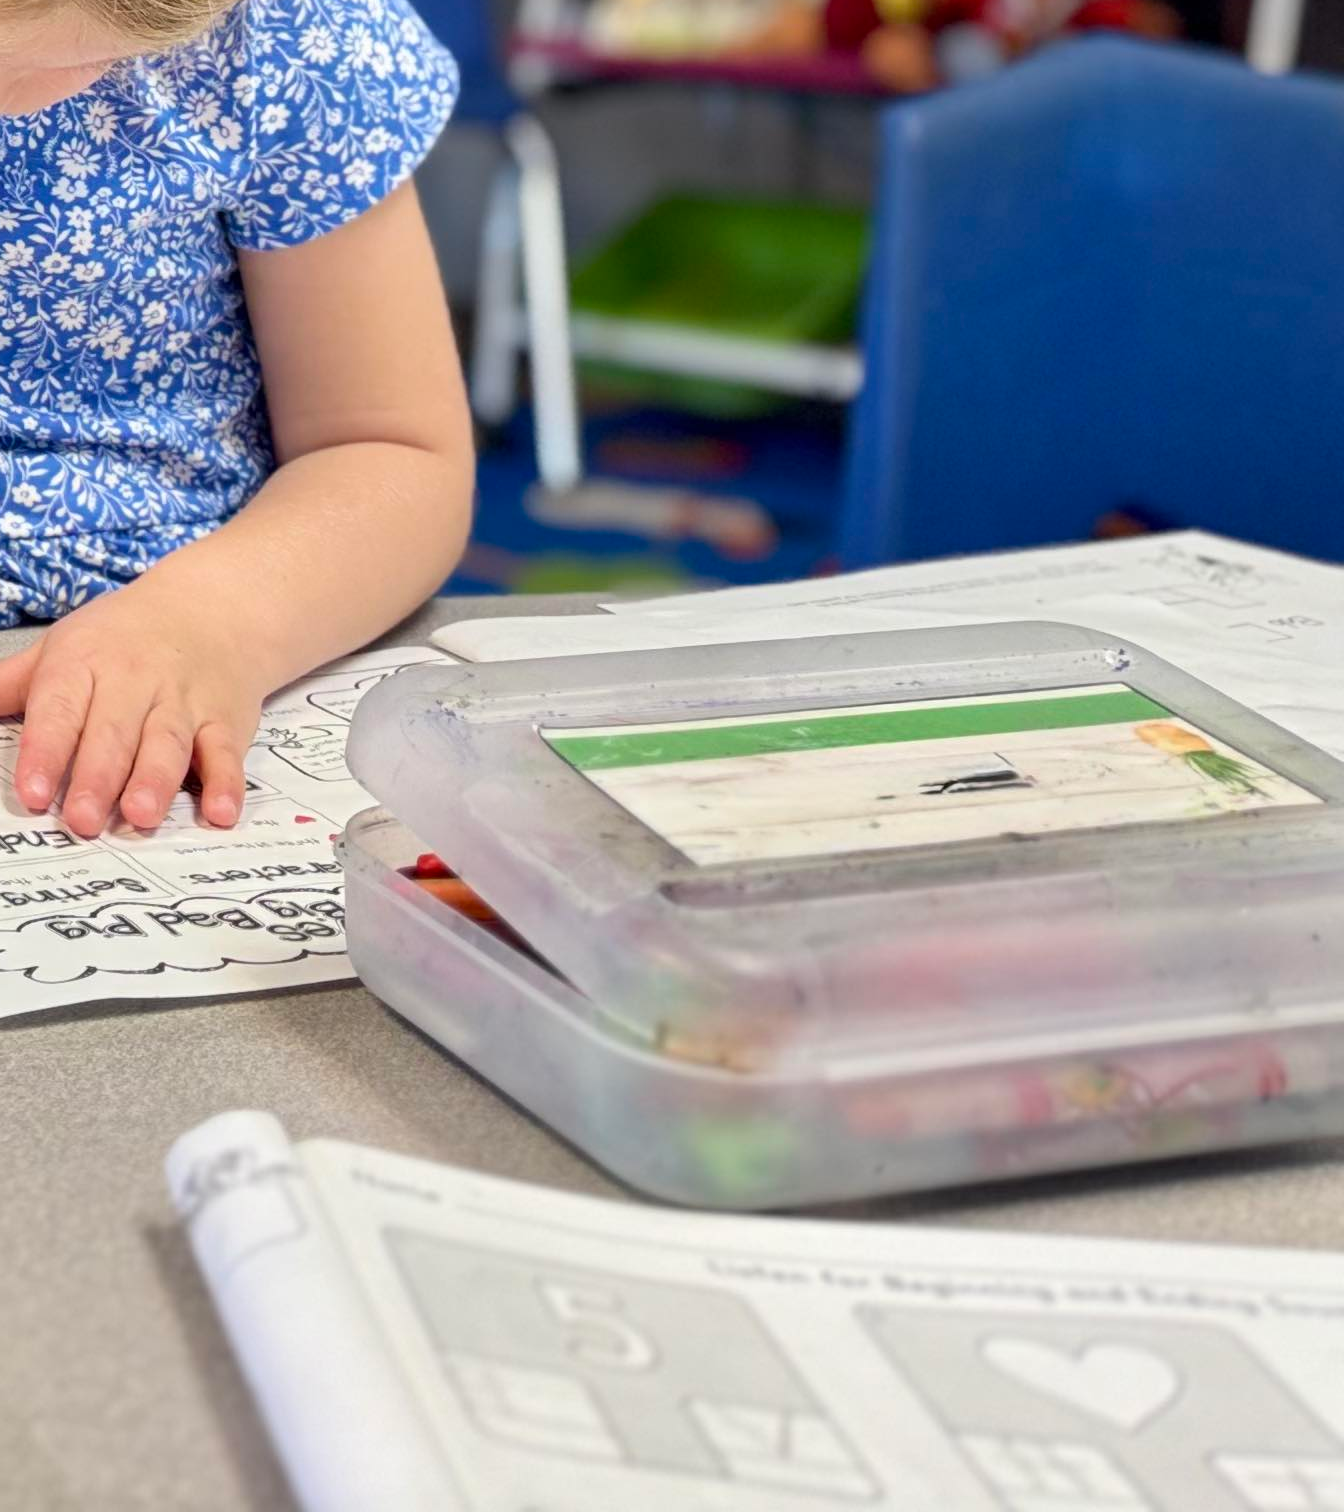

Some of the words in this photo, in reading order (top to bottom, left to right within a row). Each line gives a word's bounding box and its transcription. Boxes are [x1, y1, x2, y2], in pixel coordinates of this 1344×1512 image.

[36, 874, 55, 885] in
[60, 868, 91, 880] out
[180, 860, 345, 886] aracters:
[255, 898, 346, 922] Big
[46, 913, 148, 940] Pig
[144, 908, 264, 937] Bad
[264, 918, 346, 942] es
